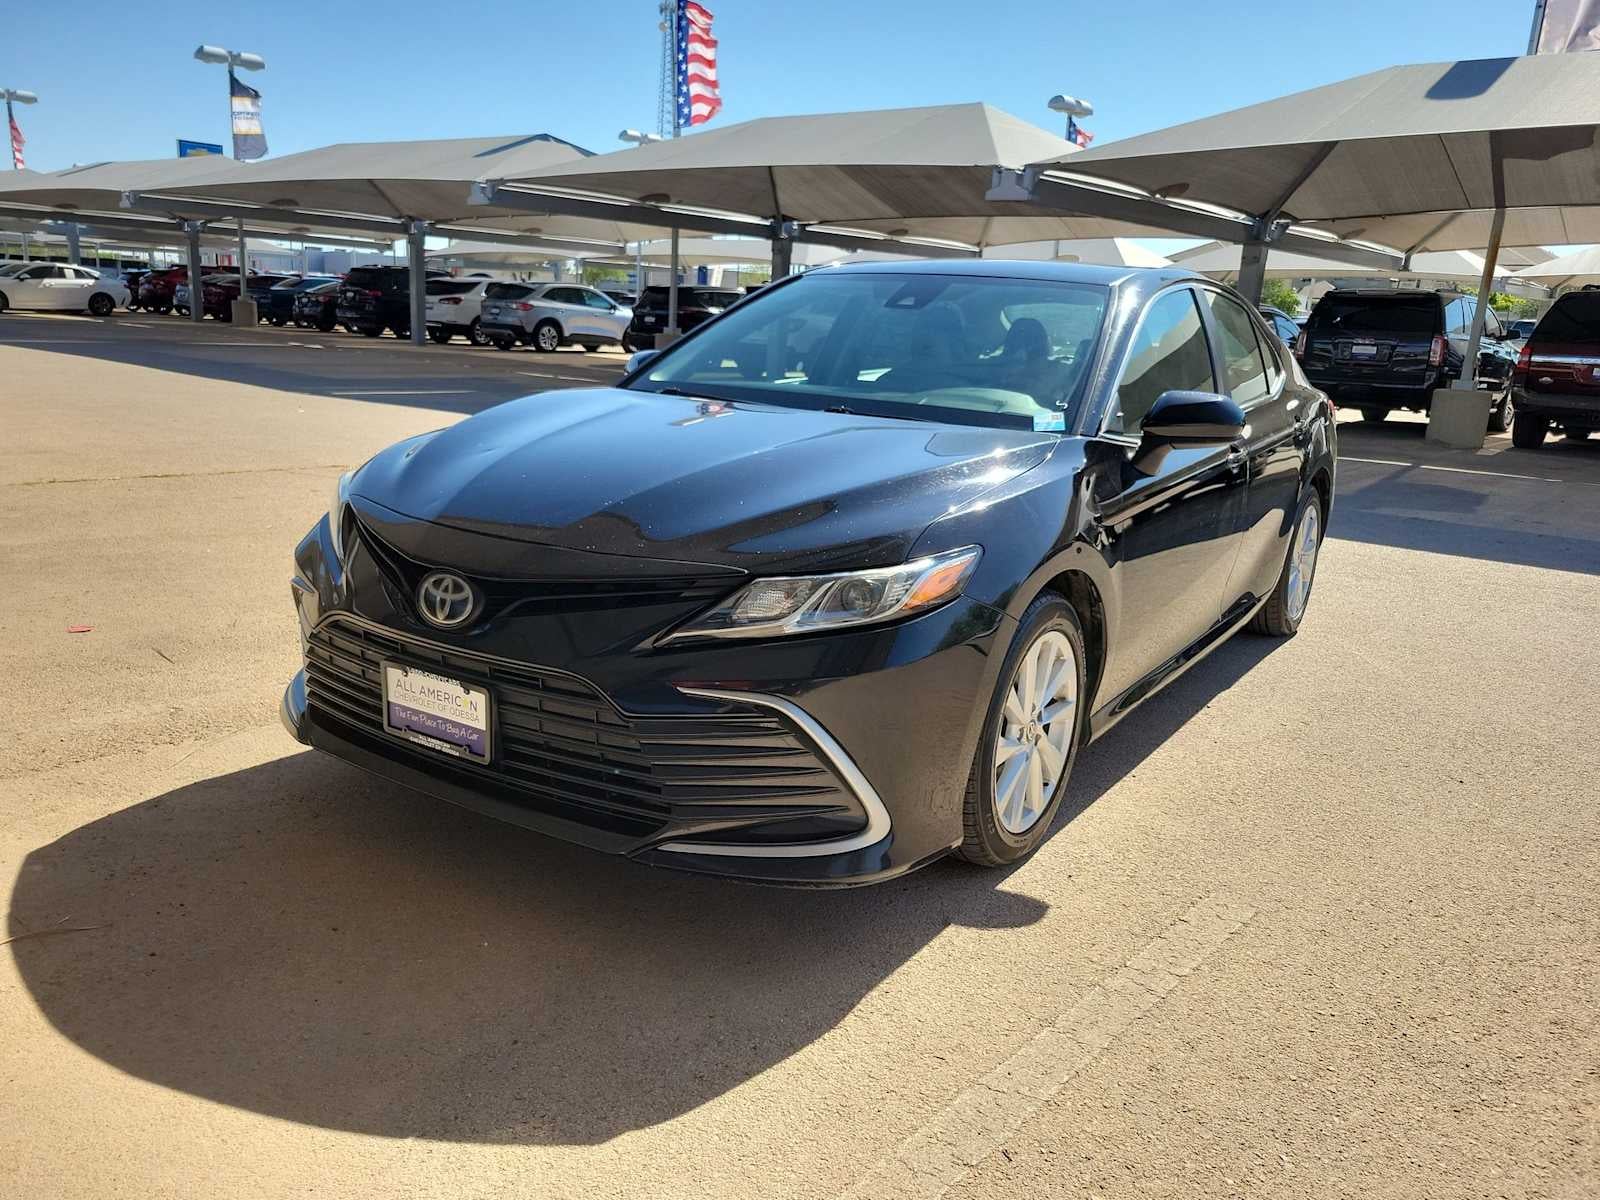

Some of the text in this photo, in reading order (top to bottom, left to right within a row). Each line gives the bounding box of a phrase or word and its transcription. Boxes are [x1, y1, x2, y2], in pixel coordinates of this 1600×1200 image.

[394, 690, 480, 723] CHEVROLET OF ODESSA
[396, 679, 478, 712] ALL AMERICN
[460, 728, 467, 737] A
